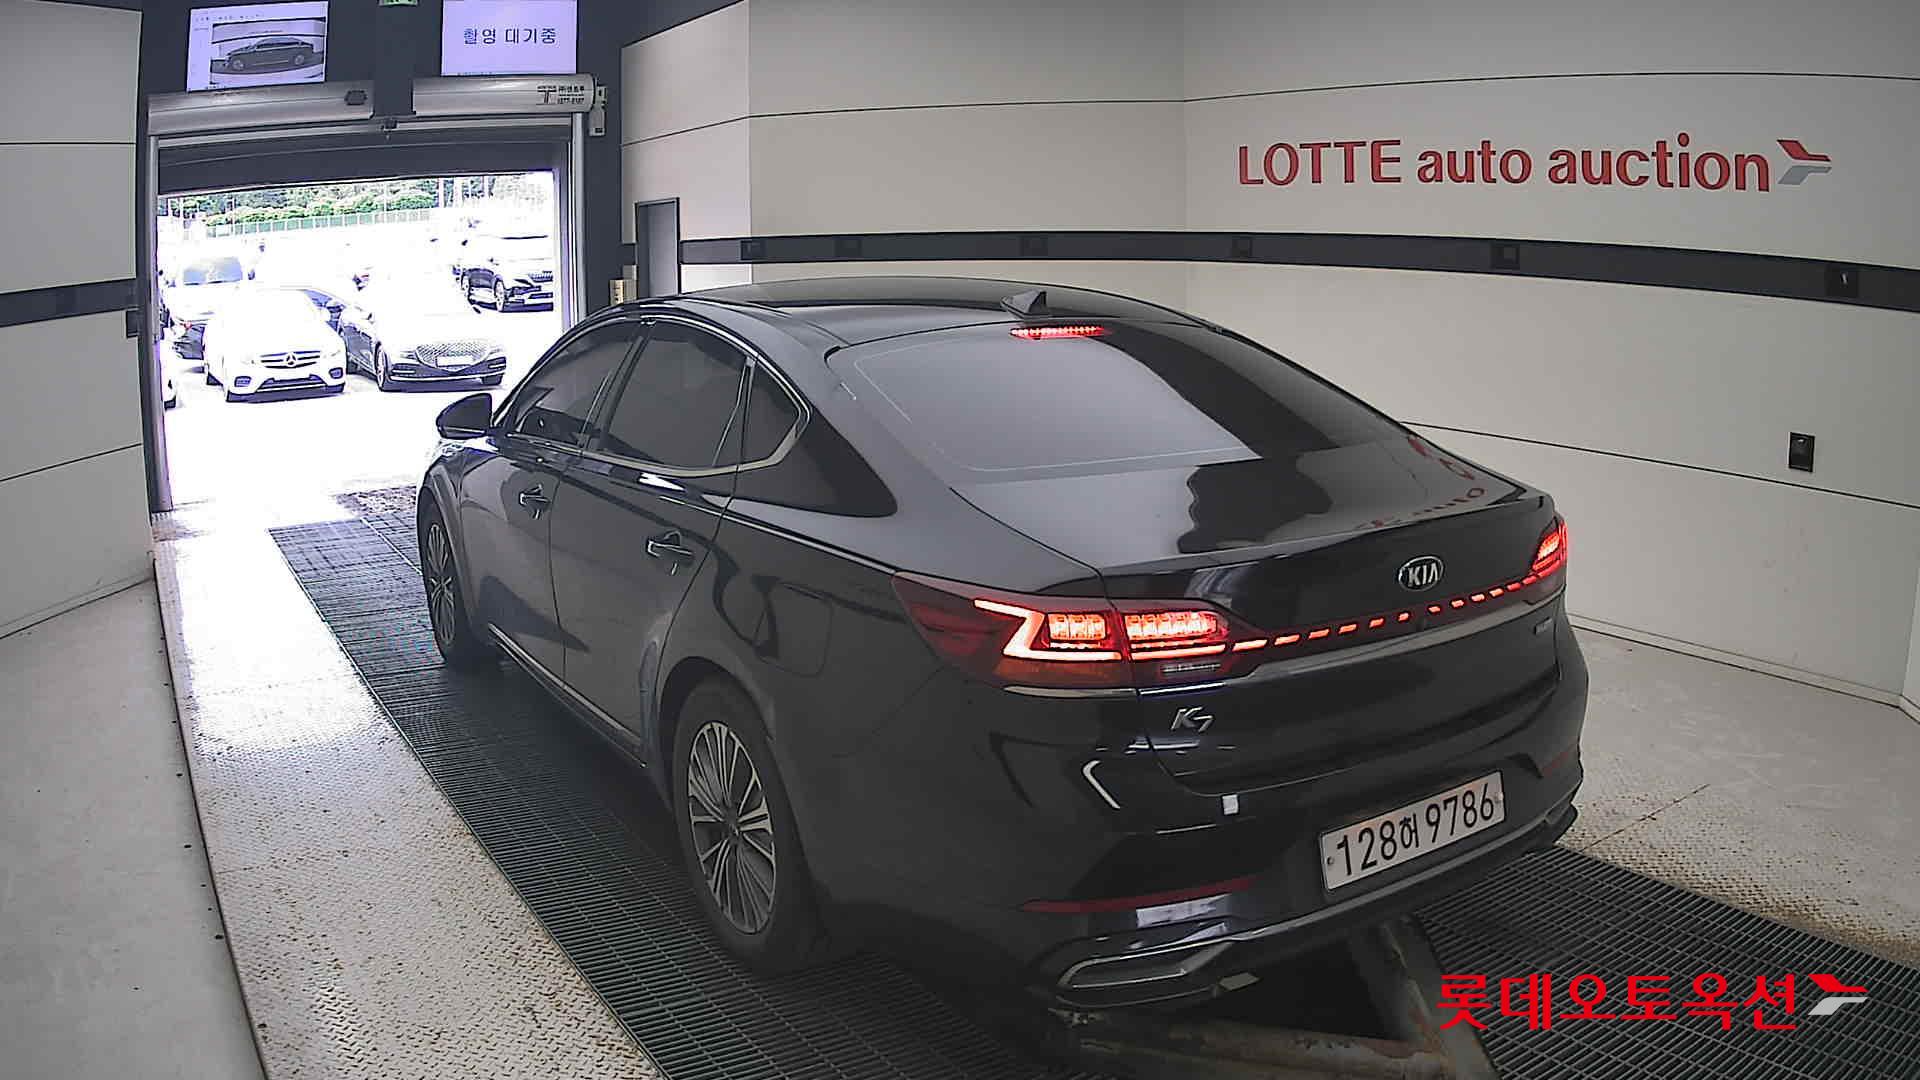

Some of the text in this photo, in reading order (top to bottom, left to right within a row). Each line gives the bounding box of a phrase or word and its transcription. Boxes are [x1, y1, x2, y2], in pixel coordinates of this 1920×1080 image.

[505, 28, 556, 44] 대기중
[1239, 133, 1769, 191] LOTTE auto auction
[1407, 562, 1438, 588] KIA
[1170, 706, 1214, 732] K7
[1336, 783, 1494, 876] 128허9786
